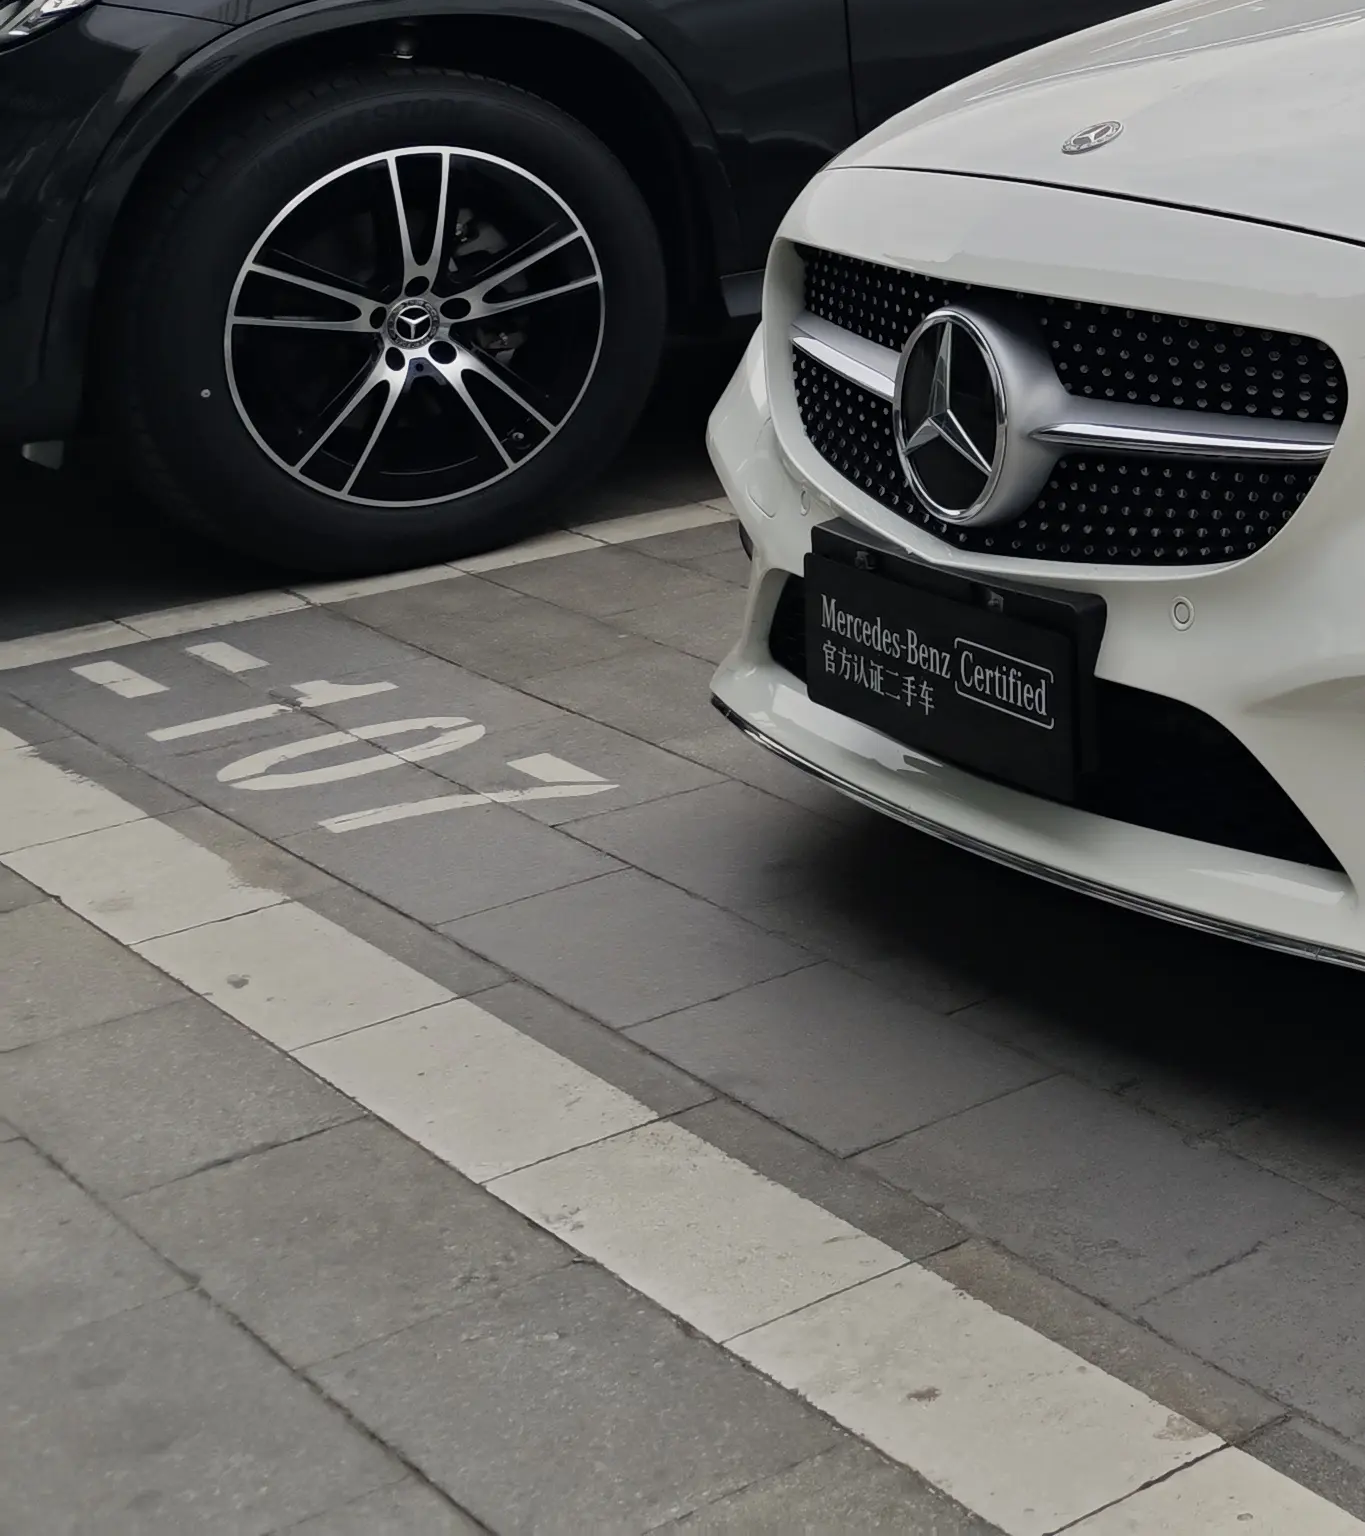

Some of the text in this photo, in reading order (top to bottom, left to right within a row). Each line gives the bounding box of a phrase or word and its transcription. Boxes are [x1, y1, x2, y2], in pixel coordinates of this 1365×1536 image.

[820, 593, 1048, 716] Mercedes-Benz Certified
[822, 640, 935, 716] 官方认证二手车
